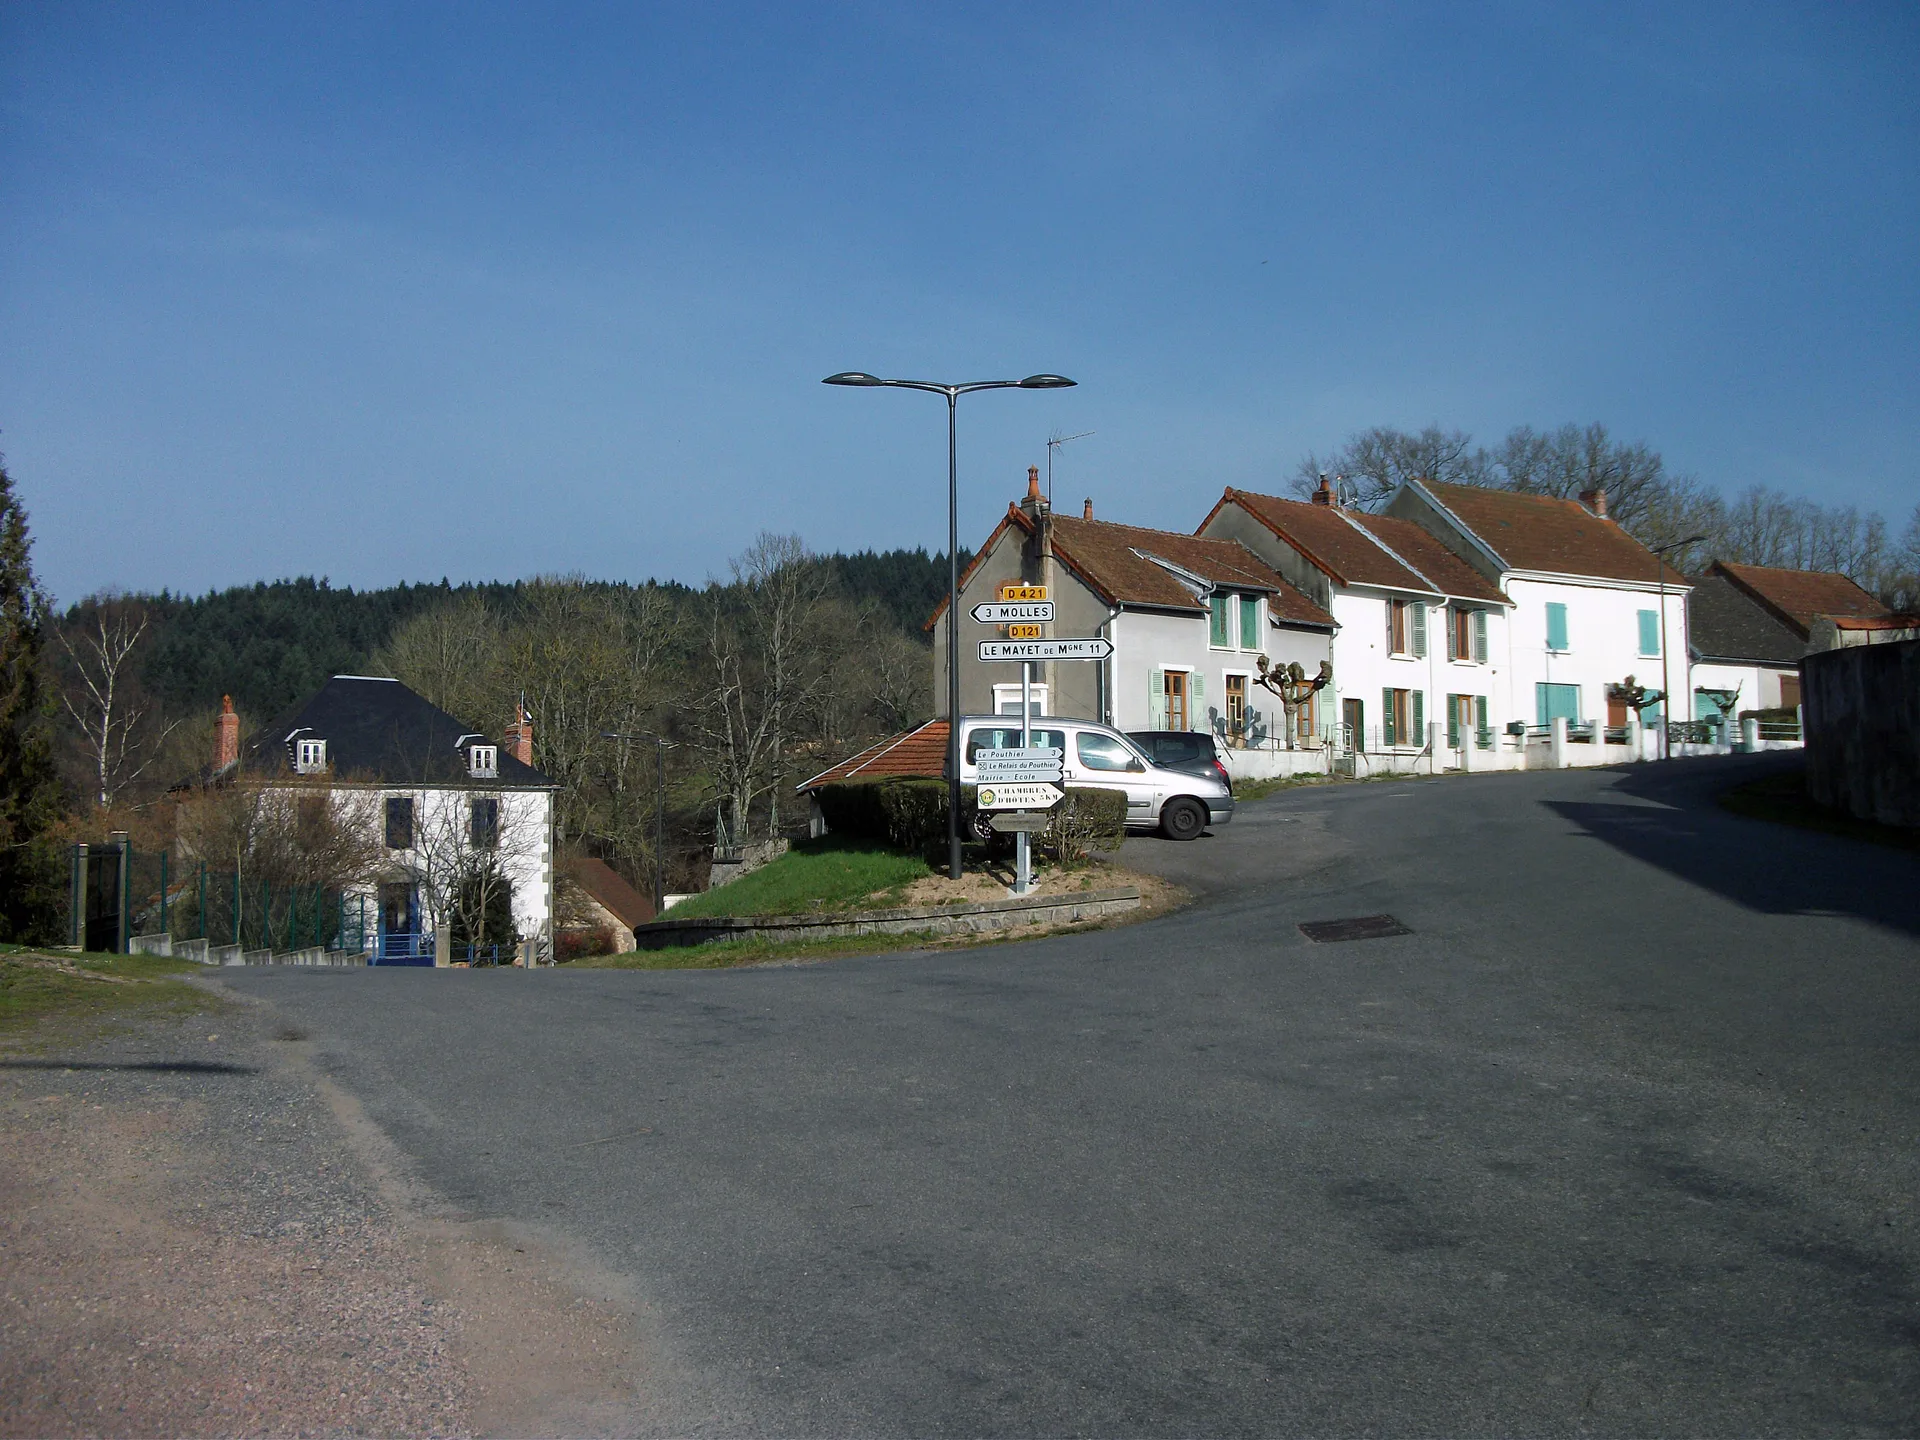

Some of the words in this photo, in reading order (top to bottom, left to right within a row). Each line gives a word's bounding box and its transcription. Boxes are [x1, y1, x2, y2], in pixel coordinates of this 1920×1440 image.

[1008, 589, 1015, 599] D
[1020, 588, 1043, 599] 421
[985, 608, 992, 618] 3
[1000, 607, 1049, 617] MOLLES
[1012, 627, 1018, 636] D
[1022, 626, 1039, 636] 121
[984, 646, 997, 656] LE
[1002, 645, 1040, 655] MAYET
[1090, 644, 1100, 654] 11
[1051, 749, 1056, 757] 3
